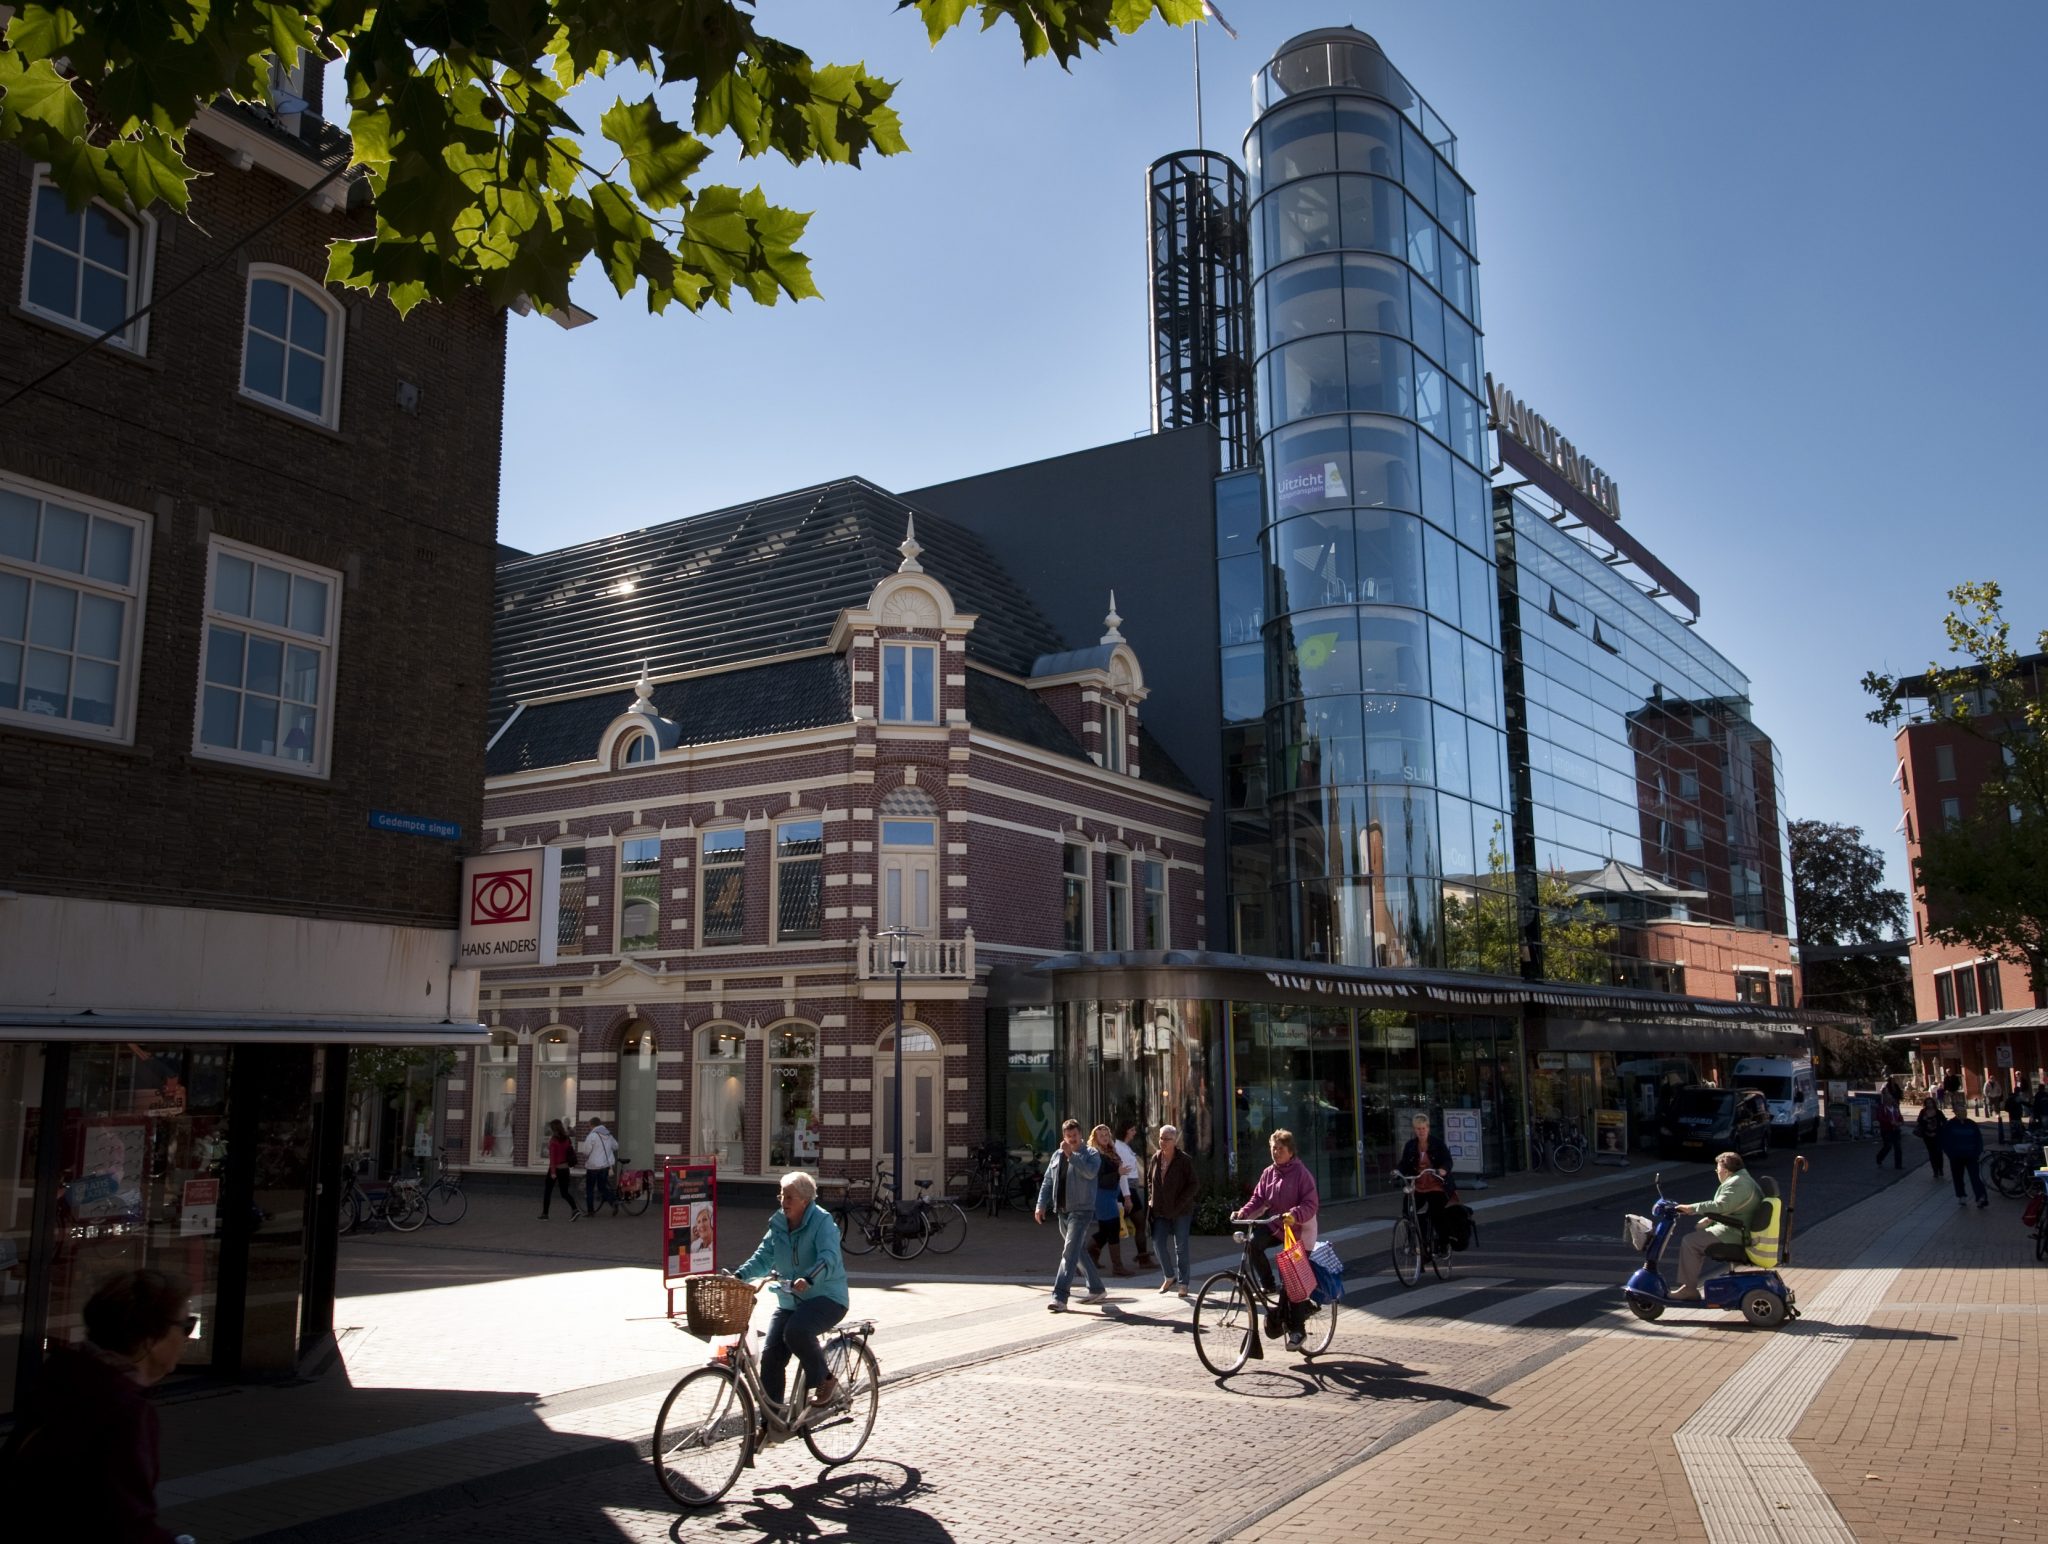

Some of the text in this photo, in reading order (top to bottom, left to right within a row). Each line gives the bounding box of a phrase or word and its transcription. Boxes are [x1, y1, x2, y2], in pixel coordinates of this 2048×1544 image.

[1486, 372, 1621, 520] VANDERVEEN
[1278, 473, 1324, 493] Uitzicht
[378, 815, 455, 836] Gedempte singel
[461, 938, 537, 956] HANS ANDERS
